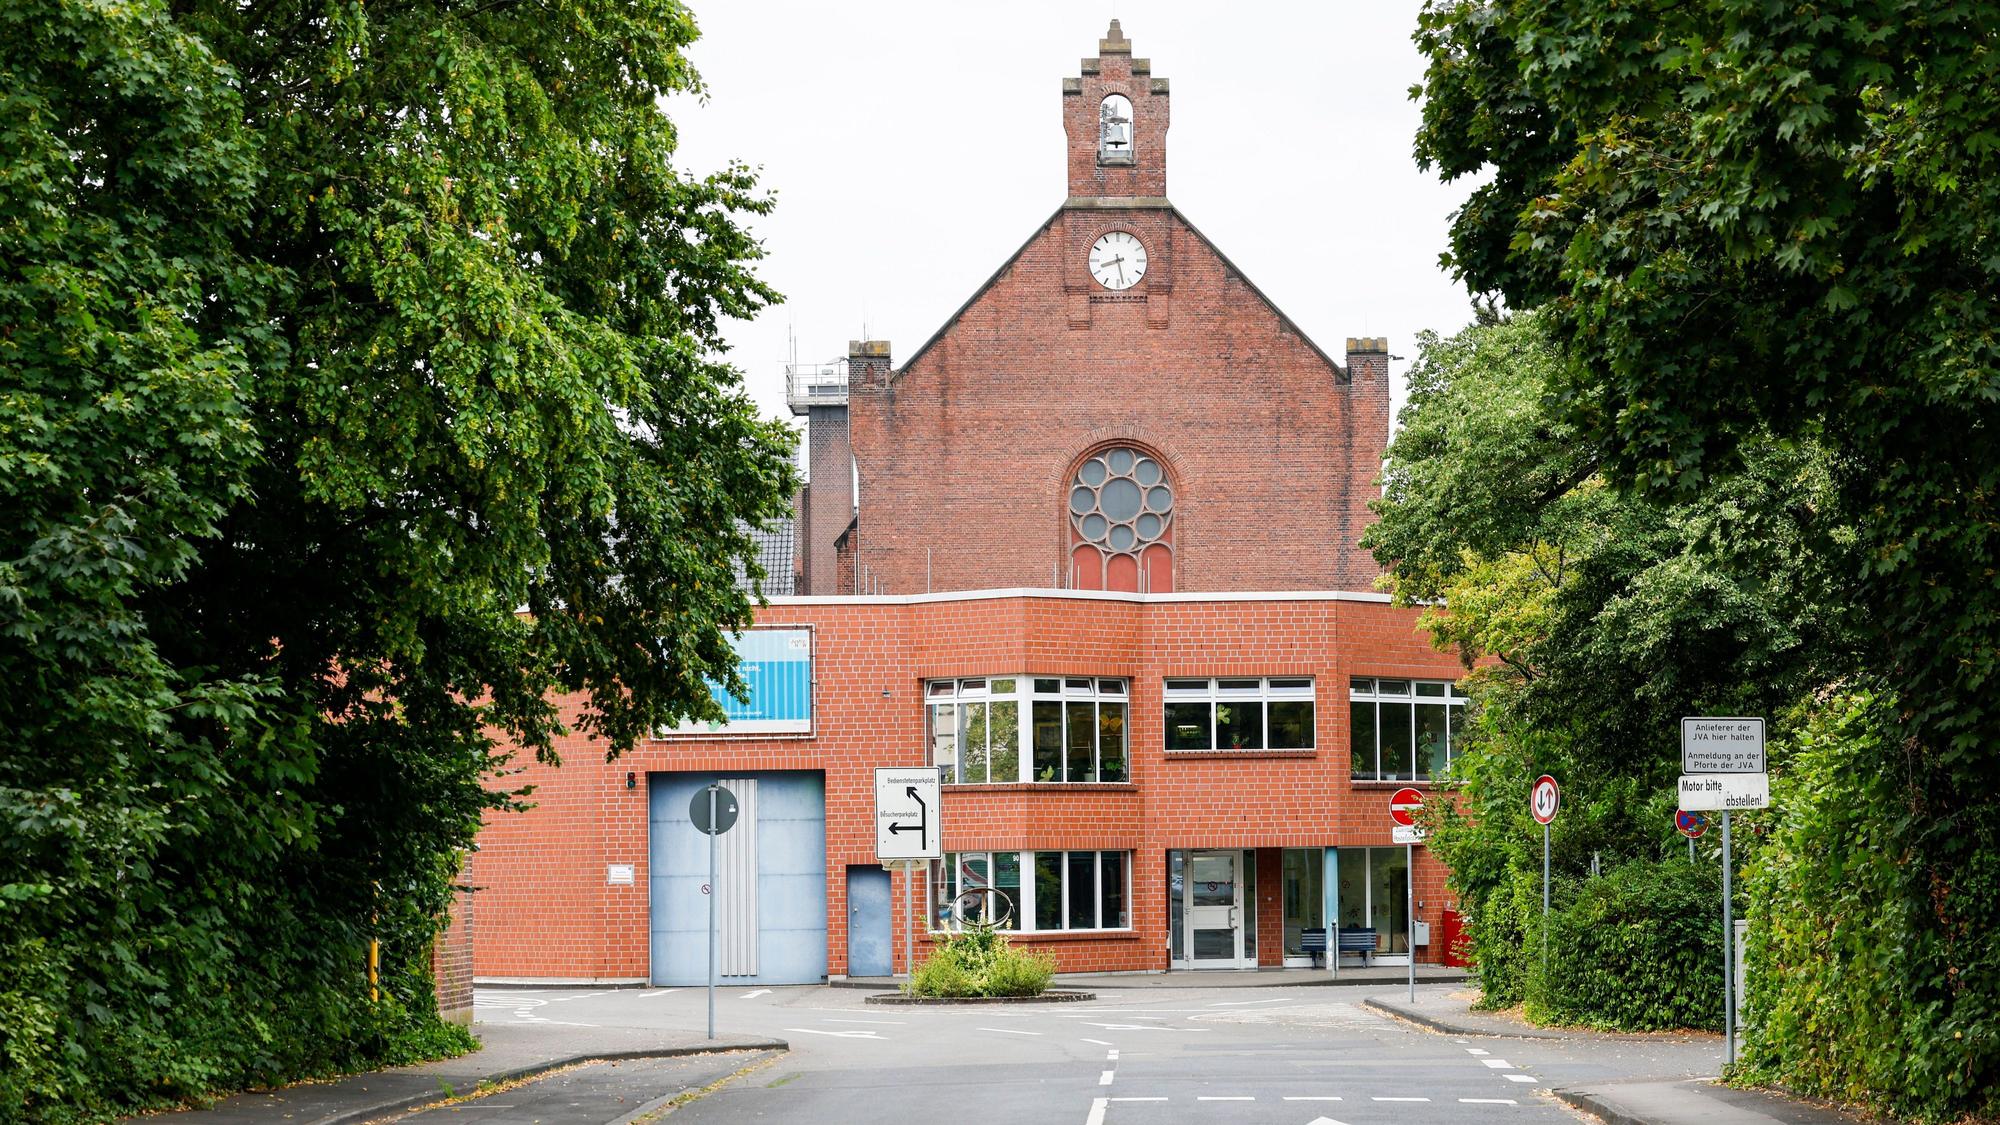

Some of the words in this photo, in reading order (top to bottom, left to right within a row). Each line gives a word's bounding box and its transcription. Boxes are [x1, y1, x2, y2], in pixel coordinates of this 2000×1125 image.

[1688, 752, 1731, 761] Anmeldung
[1746, 752, 1760, 760] der
[1682, 780, 1703, 792] Motor
[1705, 779, 1722, 791] bitte
[1725, 793, 1762, 806] abstellen!
[880, 810, 918, 818] Besucherparkplatz
